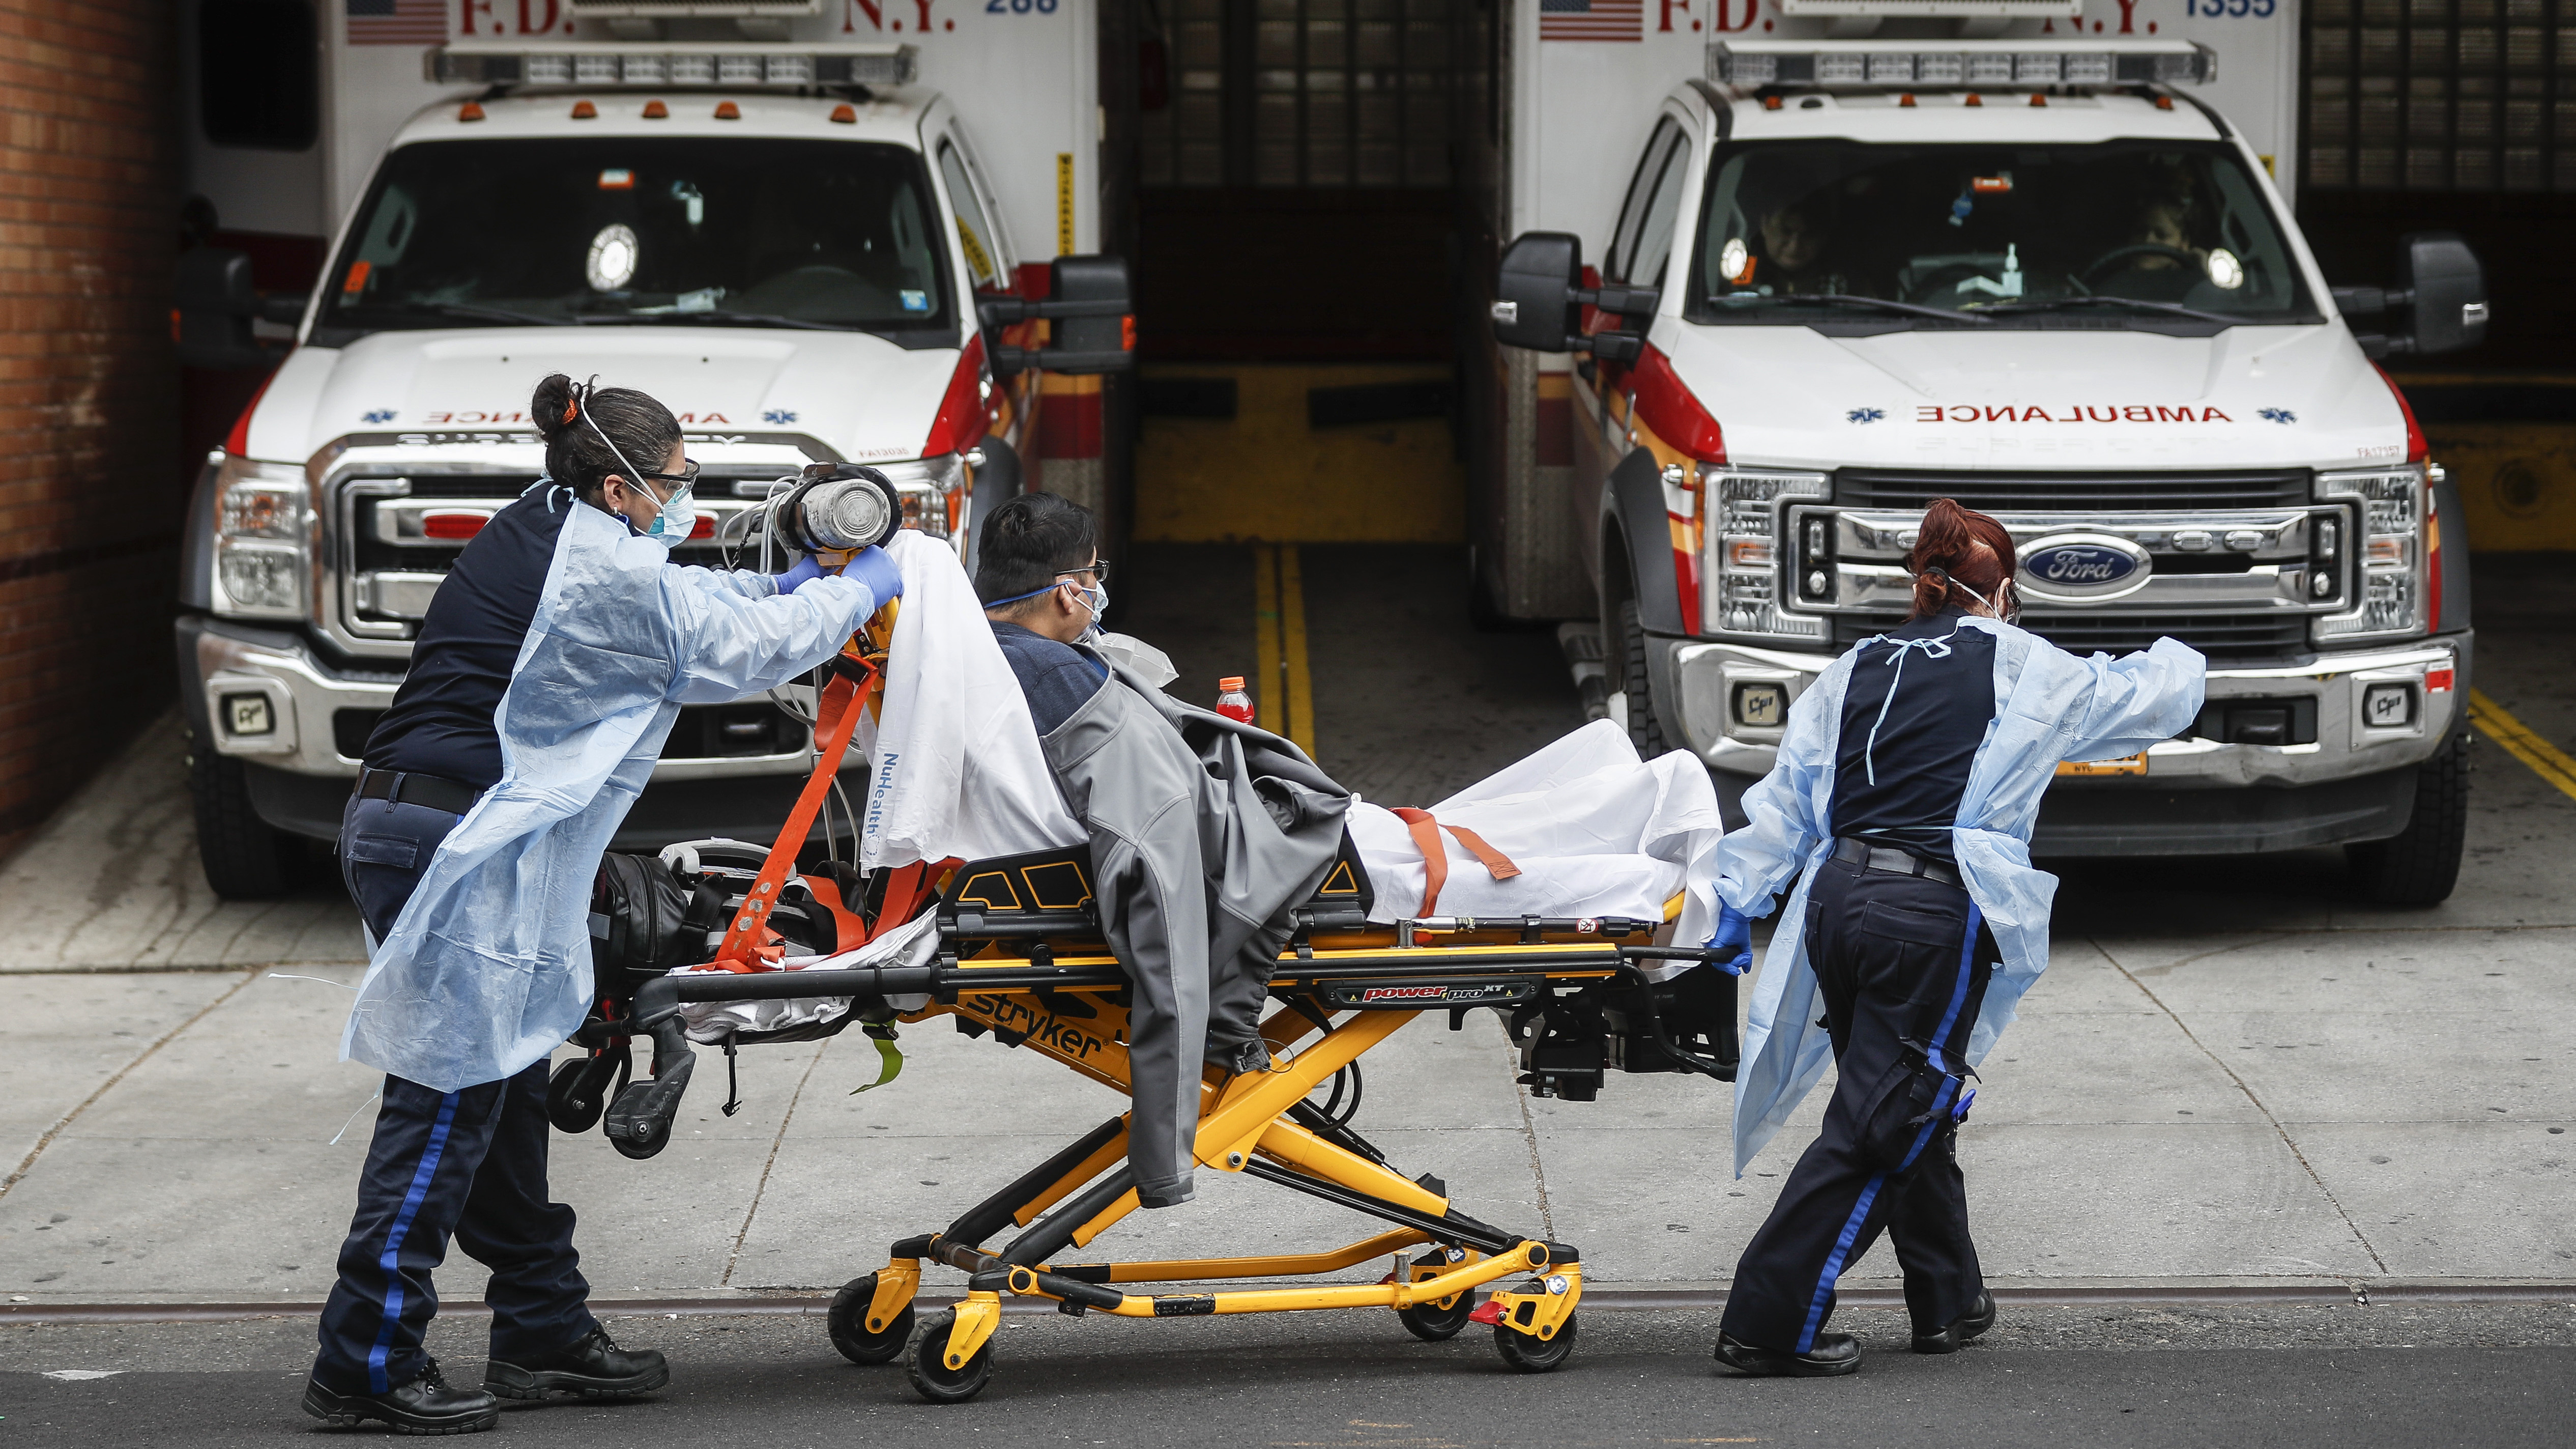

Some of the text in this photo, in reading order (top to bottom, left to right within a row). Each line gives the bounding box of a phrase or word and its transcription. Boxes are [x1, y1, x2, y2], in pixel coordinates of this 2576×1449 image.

[462, 0, 574, 35] F.D.
[842, 0, 956, 33] N.Y.
[1658, 0, 1774, 33] F.D.
[2048, 550, 2115, 579] Ford
[866, 753, 899, 834] NuHealth
[1362, 986, 1448, 1002] power
[1446, 989, 1484, 1001] pro
